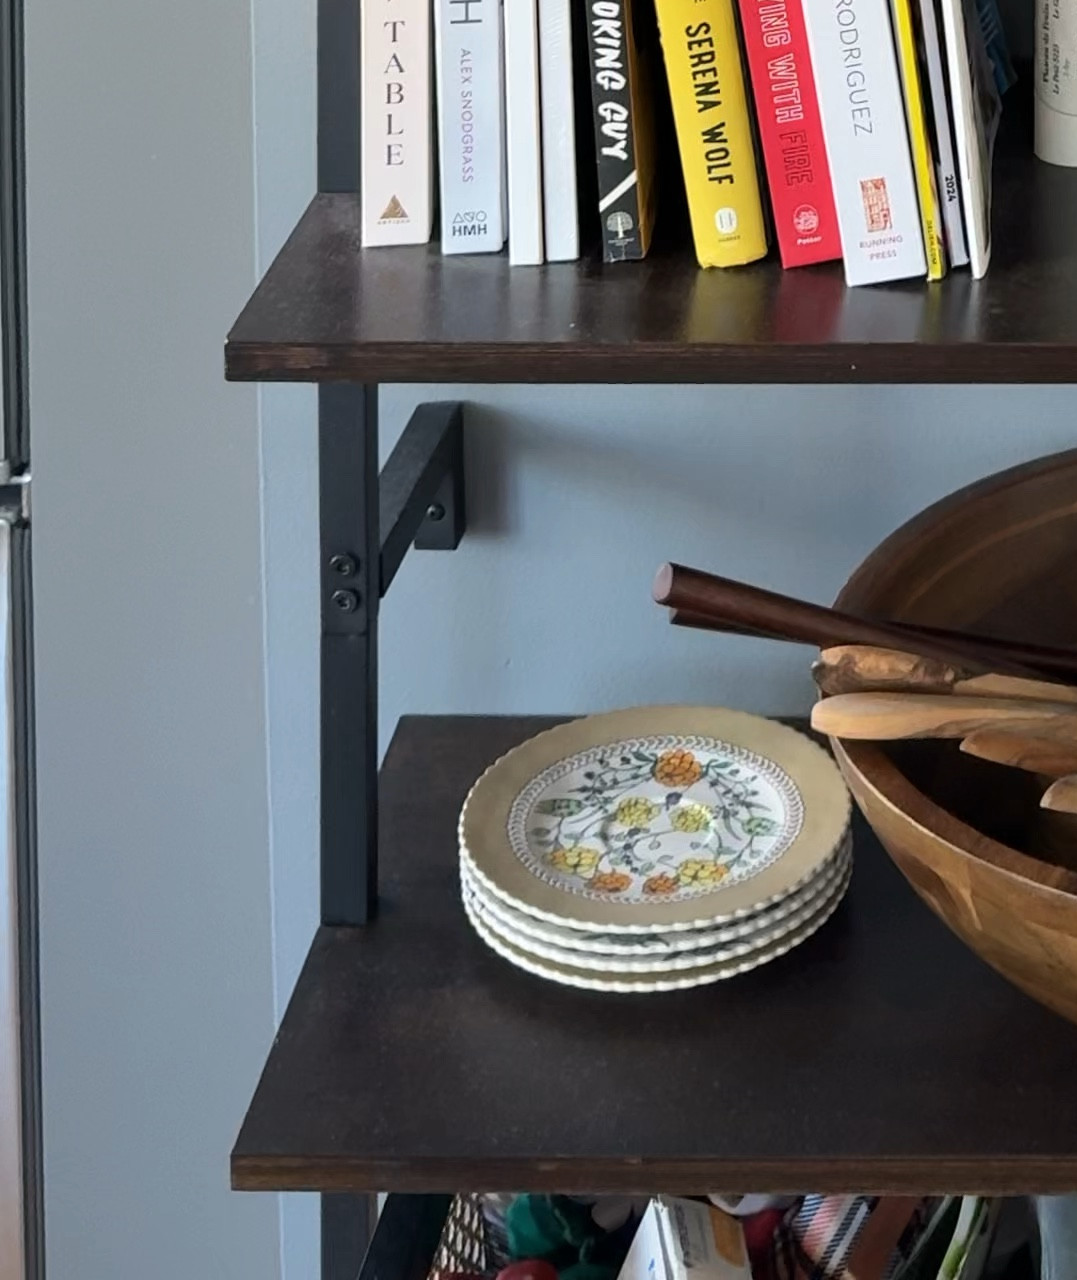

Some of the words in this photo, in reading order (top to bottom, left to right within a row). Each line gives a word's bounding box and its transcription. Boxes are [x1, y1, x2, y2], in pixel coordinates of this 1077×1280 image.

[383, 20, 405, 167] TABLE
[460, 48, 472, 85] ALEX
[685, 22, 722, 113] SERENA
[767, 53, 804, 124] WITH
[461, 90, 474, 183] SNODGRASS
[598, 101, 628, 161] GUY
[701, 122, 734, 184] WOLF
[780, 130, 814, 187] FIRE
[945, 176, 957, 202] 2024
[452, 224, 488, 236] HMH
[859, 235, 904, 249] RUNNING
[869, 249, 897, 261] PRESS
